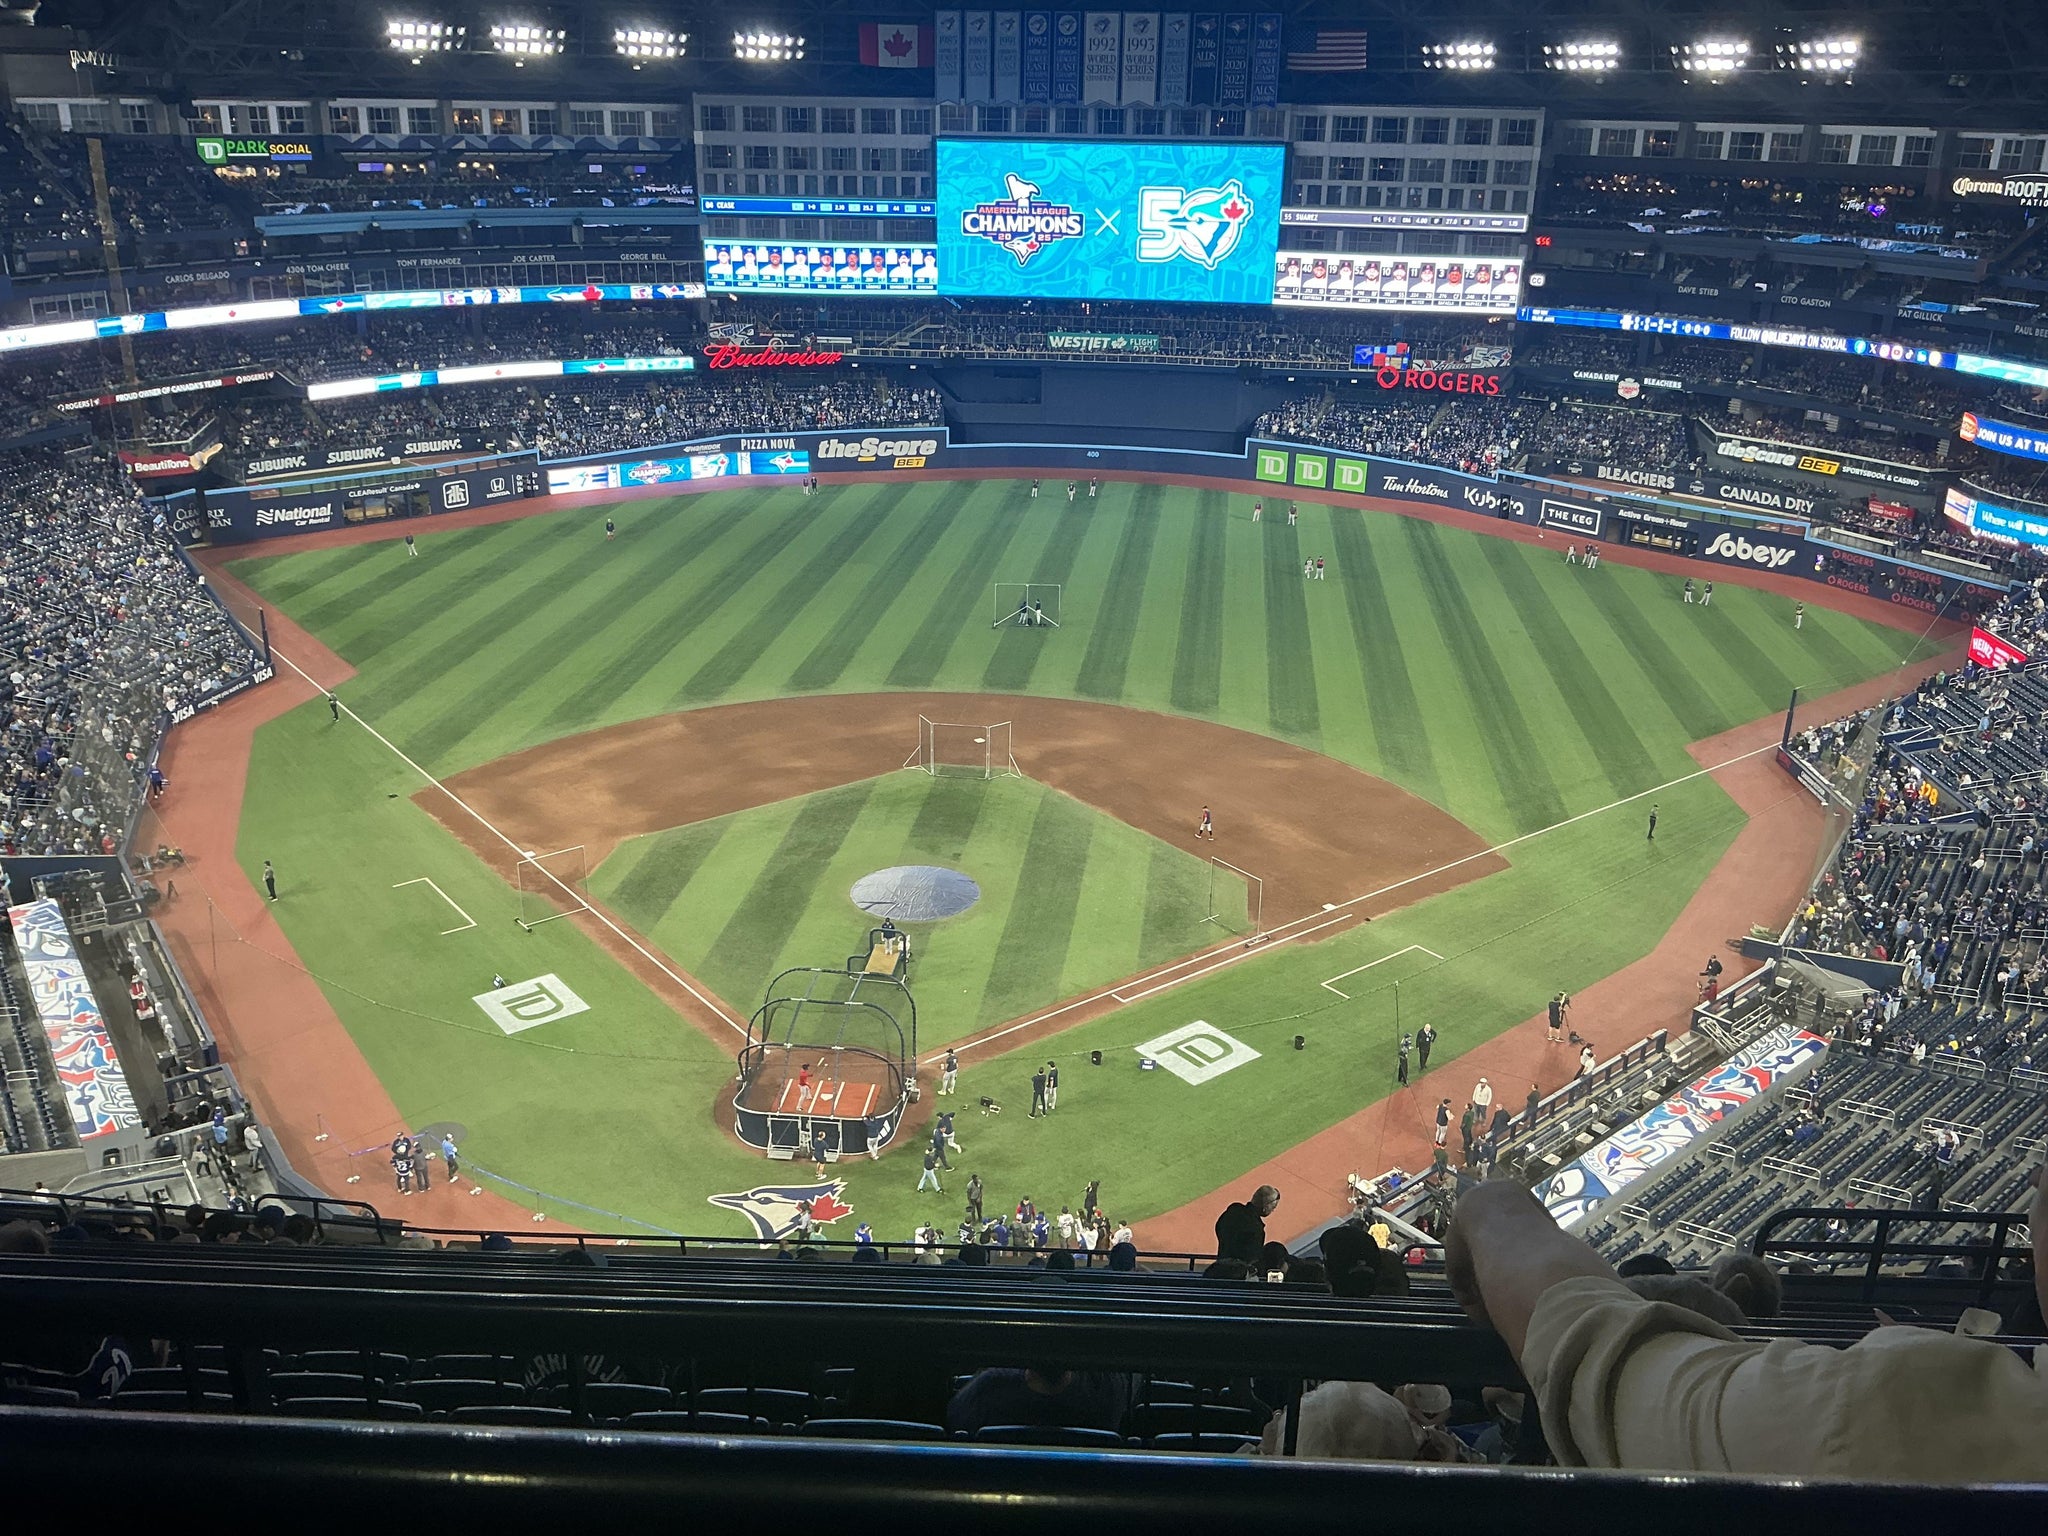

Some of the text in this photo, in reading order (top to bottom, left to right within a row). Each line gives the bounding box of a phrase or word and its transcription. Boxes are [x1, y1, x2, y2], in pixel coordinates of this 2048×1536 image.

[1028, 37, 1047, 47] 1992
[1058, 37, 1077, 47] 1993
[1089, 37, 1116, 52] 1992
[1127, 38, 1155, 52] 1993
[1196, 39, 1216, 49] 2016
[1087, 54, 1117, 65] WORLD
[1125, 54, 1155, 65] WORLD
[1197, 51, 1216, 61] ALDS
[1086, 65, 1117, 75] SERIES
[1124, 65, 1155, 75] SERIES
[1224, 60, 1246, 70] 2020
[1224, 74, 1245, 85] 2022
[1028, 82, 1048, 92] ALCS
[1057, 82, 1077, 92] ALCS
[199, 140, 312, 159] TD PARK SOCIAL
[1953, 177, 2003, 197] Corona
[716, 201, 736, 210] CEASE
[979, 206, 1068, 216] AMERICAN LEAGUE
[1284, 213, 1293, 221] 55
[1295, 213, 1319, 221] SUAREZ
[963, 213, 1082, 235] CHAMPIONS
[998, 233, 1052, 242] 20 25
[396, 257, 462, 268] TONY FERNANDEZ
[512, 254, 556, 263] JOE CARTER
[620, 252, 667, 261] GEORGE BELL
[286, 262, 350, 274] 4306 TOM CHEEK
[1277, 263, 1286, 272] 16
[1302, 264, 1313, 273] 40
[1329, 265, 1338, 274] 19
[1354, 266, 1365, 275] 52
[1382, 267, 1391, 276] 10
[1410, 268, 1418, 277] 11
[1438, 269, 1445, 278] 3
[165, 271, 230, 284] CARLOS DELGADO
[1465, 270, 1476, 279] 75
[1494, 270, 1500, 279] 5
[1678, 285, 1719, 297] DAVE STIEB
[1781, 295, 1831, 309] CITO GASTON
[1898, 309, 1943, 322] PAT GILLICK
[2014, 324, 2033, 336] PAUL
[1049, 335, 1158, 351] WESTJET FLIGHT
[1730, 326, 1761, 341] FOLLOW
[1820, 336, 1847, 351] SOCIAL
[703, 344, 843, 369] Budweiser
[242, 371, 266, 383] ROGERS
[1404, 369, 1500, 396] ROGERS
[1573, 370, 1683, 389] CANADA DRY BLEACHERS
[115, 378, 222, 402] PROUD OWNER OF CANADA'S TEAM
[65, 399, 90, 411] ROGERS
[741, 437, 796, 450] PIZZA NOVA
[1977, 427, 1998, 443] JOIN
[1998, 433, 2014, 447] US
[2014, 437, 2032, 451] AT
[404, 437, 463, 455] SUBWAY
[817, 437, 938, 460] theScore
[326, 445, 386, 464] SUBWAY
[134, 459, 190, 472] BeautiTone
[249, 454, 308, 475] SUBWAY
[895, 457, 925, 468] BET
[1261, 455, 1285, 476] TD
[1717, 441, 1797, 467] theScore
[1800, 457, 1837, 474] BET
[1842, 466, 1886, 482] SPORTSBOOK
[1893, 475, 1920, 487] CASINO
[1298, 460, 1323, 481] TD
[1337, 464, 1363, 485] TD
[1597, 465, 1676, 490] BLEACHERS
[389, 483, 415, 493] Canada
[1383, 475, 1449, 499] Tim Hortons
[1719, 484, 1783, 509] CANADA
[1784, 496, 1815, 514] DRY
[273, 503, 331, 523] National
[1548, 508, 1594, 526] THE KEG
[1618, 509, 1642, 520] Active
[1981, 510, 2007, 527] Where
[295, 516, 330, 527] Car Rental
[1704, 532, 1796, 568] Sobeys
[1841, 552, 1874, 568] ROGERS
[1906, 570, 1942, 585] ROGERS
[1836, 578, 1870, 594] ROGERS
[1900, 595, 1936, 612] ROGERS
[1972, 637, 1994, 660] HEINZ
[501, 982, 564, 1021] TD
[1154, 1033, 1234, 1070] TD
